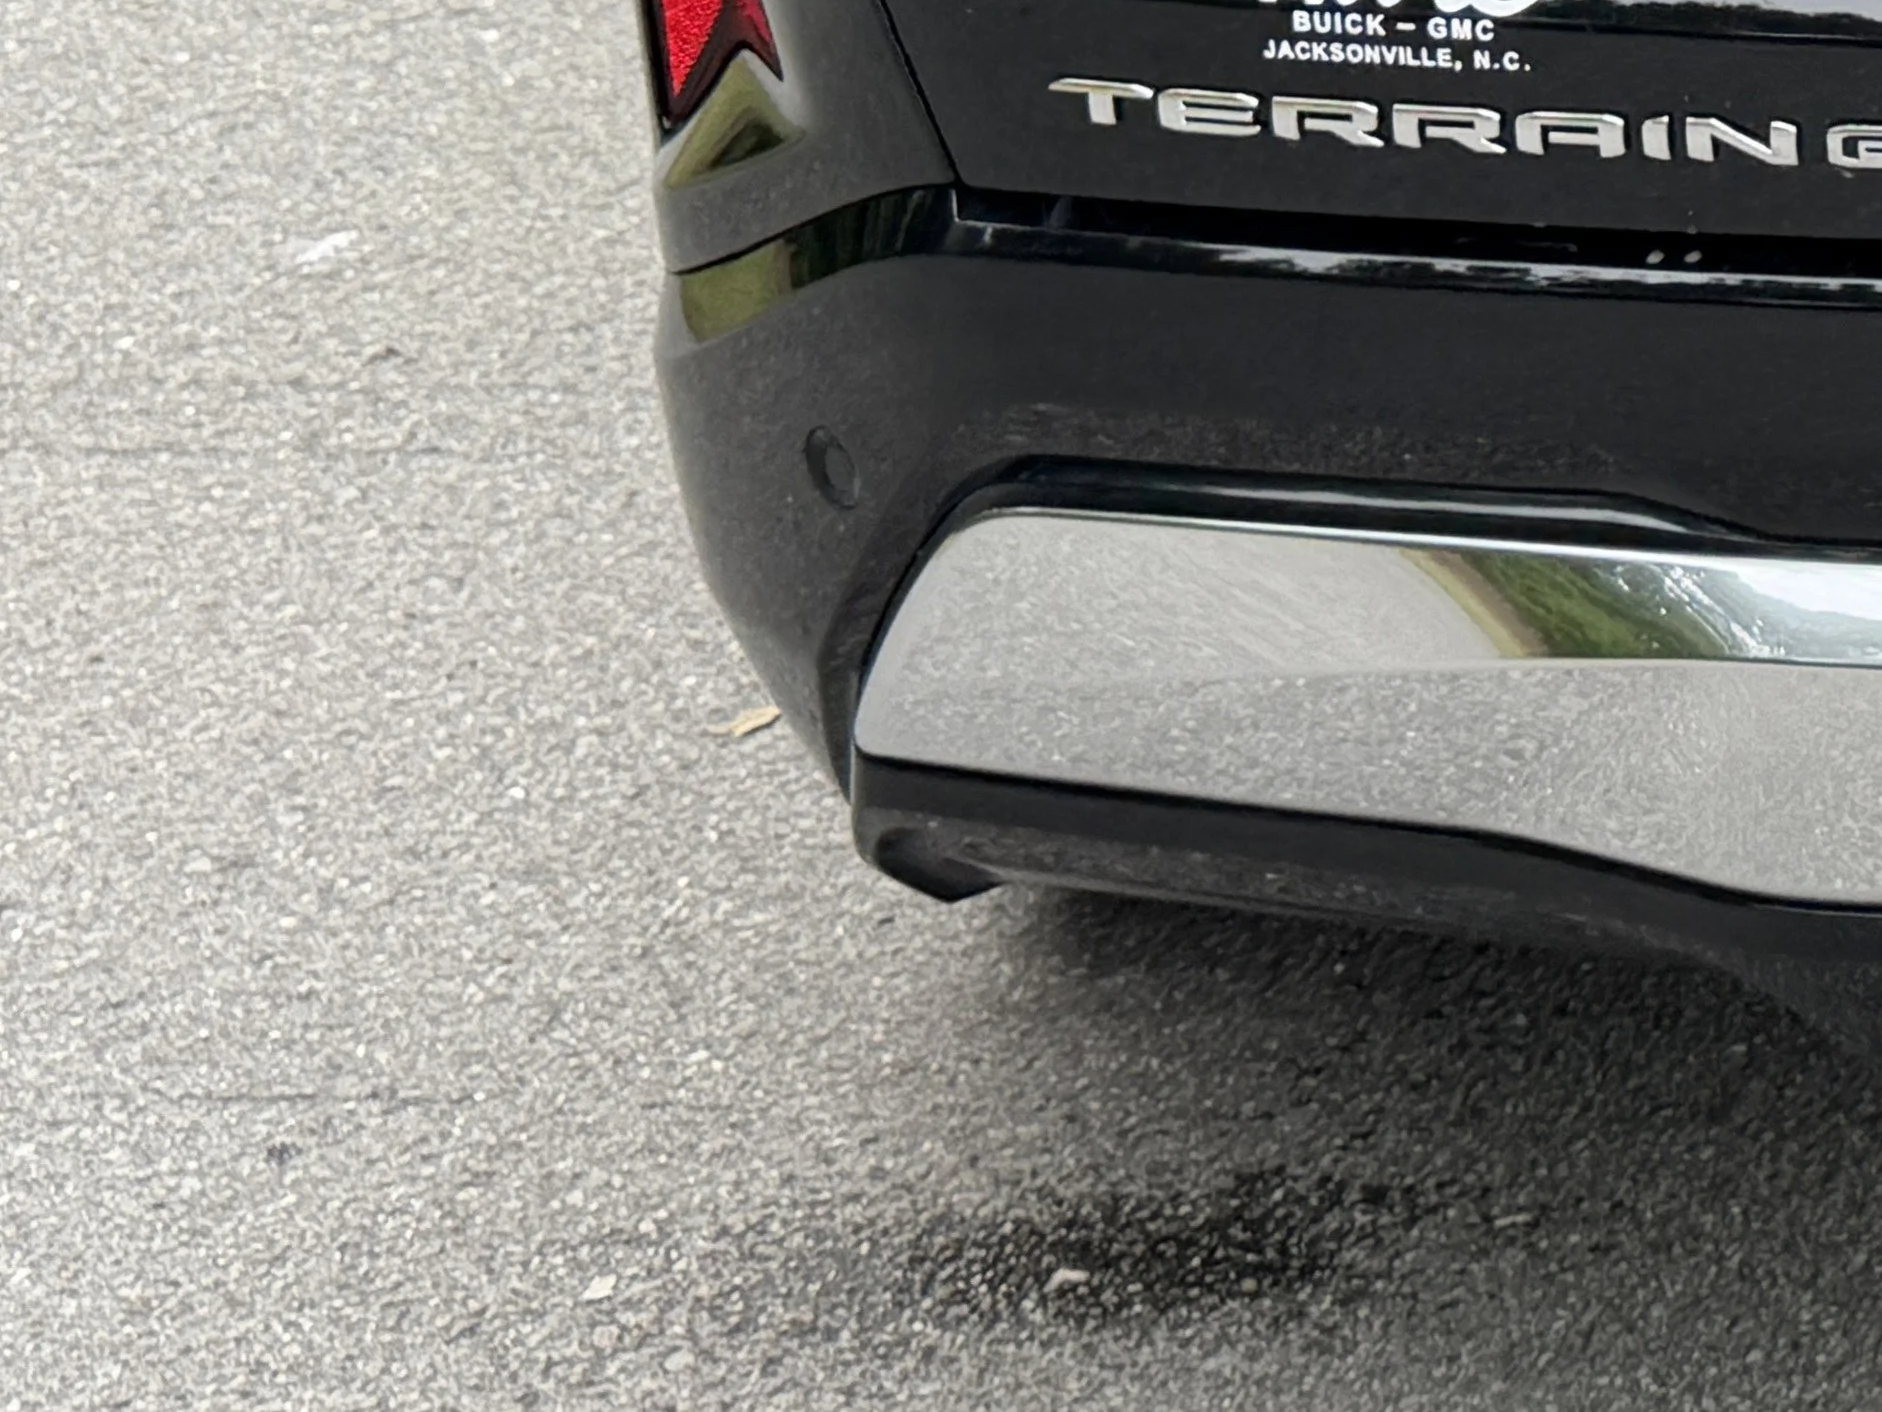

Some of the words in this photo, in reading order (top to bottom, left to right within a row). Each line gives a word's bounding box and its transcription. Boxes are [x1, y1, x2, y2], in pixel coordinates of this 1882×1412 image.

[1292, 10, 1386, 37] BUICK
[1426, 16, 1495, 42] GMC
[1263, 39, 1462, 72] JACKSONVILLE,
[1473, 50, 1532, 72] N.C.
[1048, 77, 1800, 167] TERRAIN
